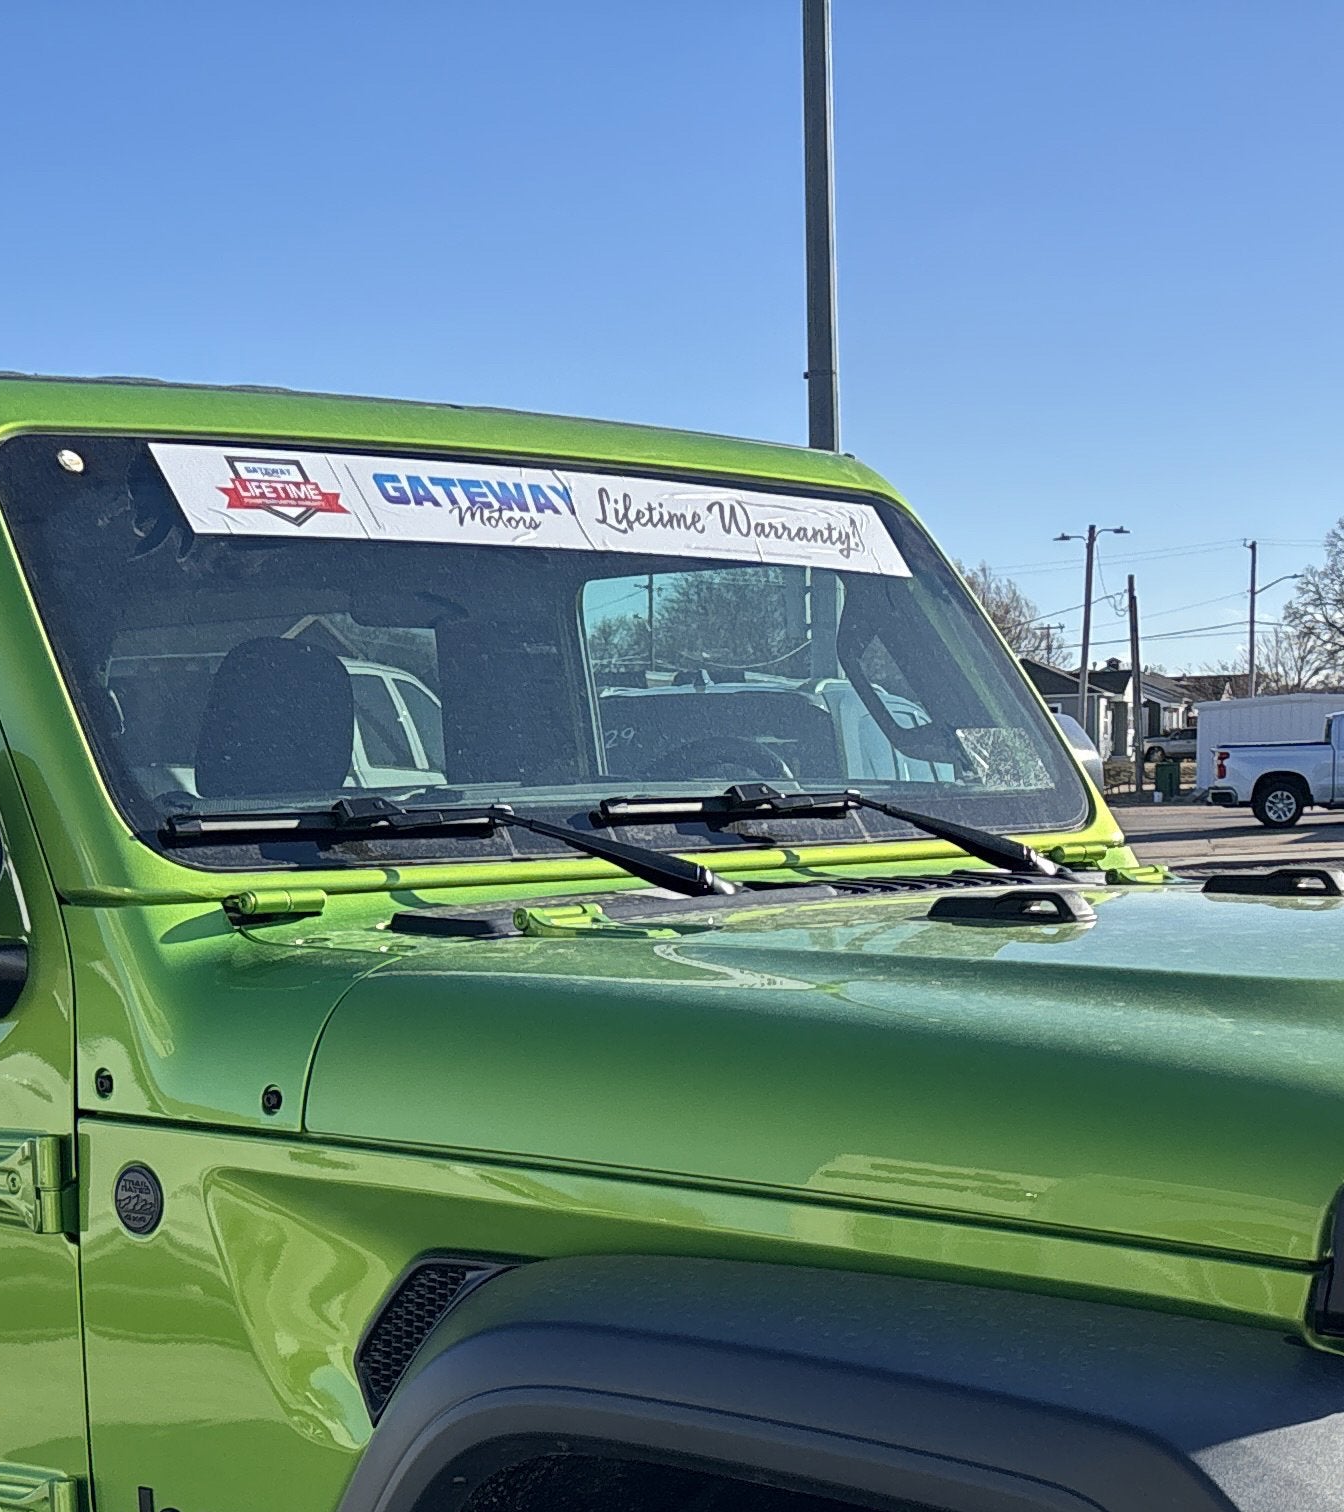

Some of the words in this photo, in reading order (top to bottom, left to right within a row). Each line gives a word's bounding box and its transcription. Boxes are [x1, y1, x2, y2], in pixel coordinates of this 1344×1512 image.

[234, 480, 323, 500] LIFETIME
[373, 472, 576, 516] GATEWAY
[449, 503, 542, 530] Motors
[595, 487, 706, 535] Lifetime
[707, 500, 862, 558] Warranty!
